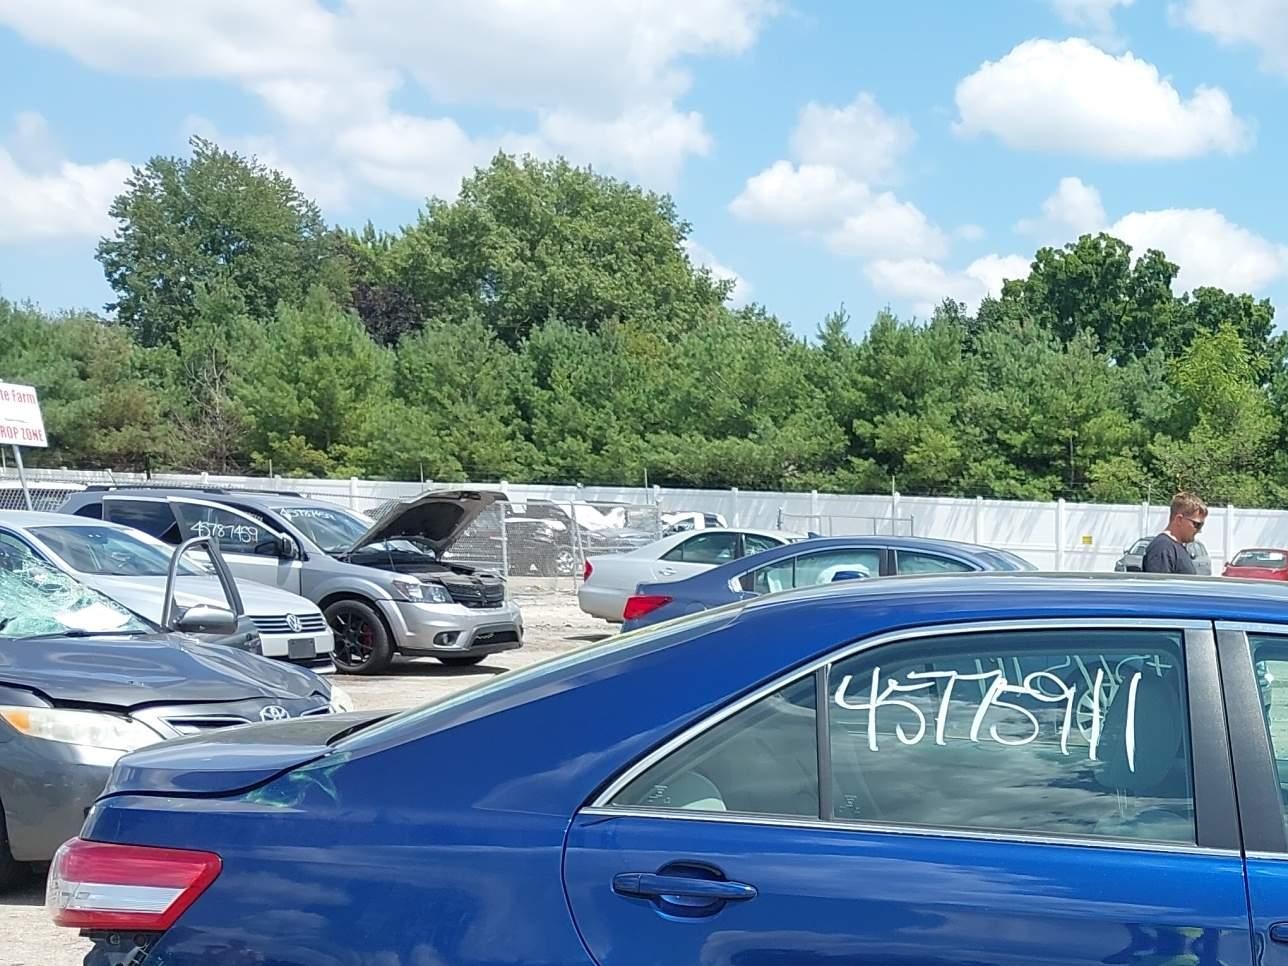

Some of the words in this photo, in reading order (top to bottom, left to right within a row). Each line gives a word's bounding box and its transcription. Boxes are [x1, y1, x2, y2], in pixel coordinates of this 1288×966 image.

[20, 428, 44, 442] ZONE
[190, 520, 258, 543] 45787459
[834, 666, 1143, 772] 45775911
